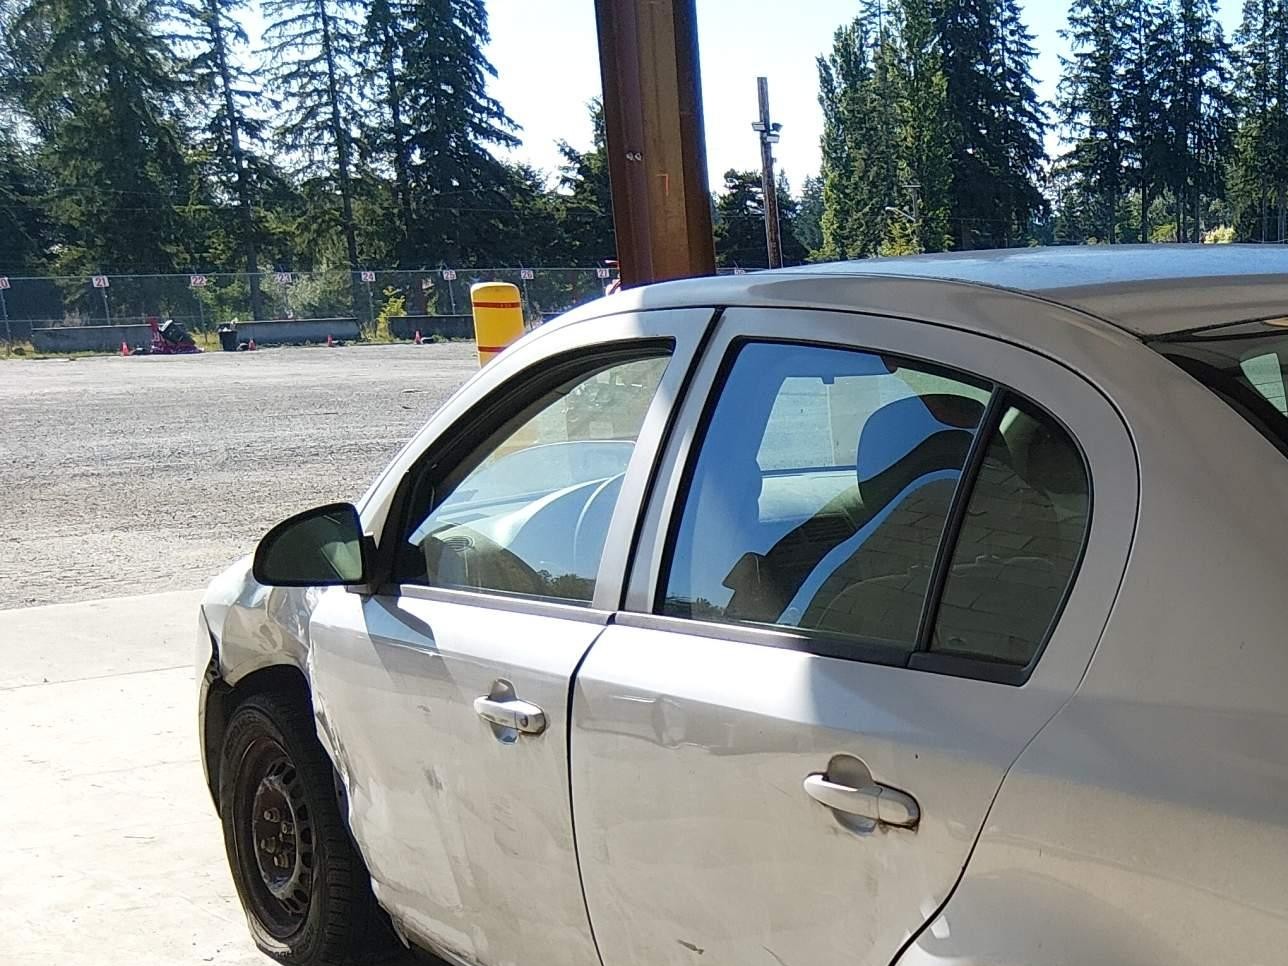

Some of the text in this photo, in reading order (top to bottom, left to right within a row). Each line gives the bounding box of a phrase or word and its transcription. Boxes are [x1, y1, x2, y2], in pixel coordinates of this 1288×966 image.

[362, 272, 374, 281] 24
[444, 270, 455, 280] 25
[521, 270, 532, 279] 26
[95, 277, 106, 287] 21
[192, 276, 204, 285] 22
